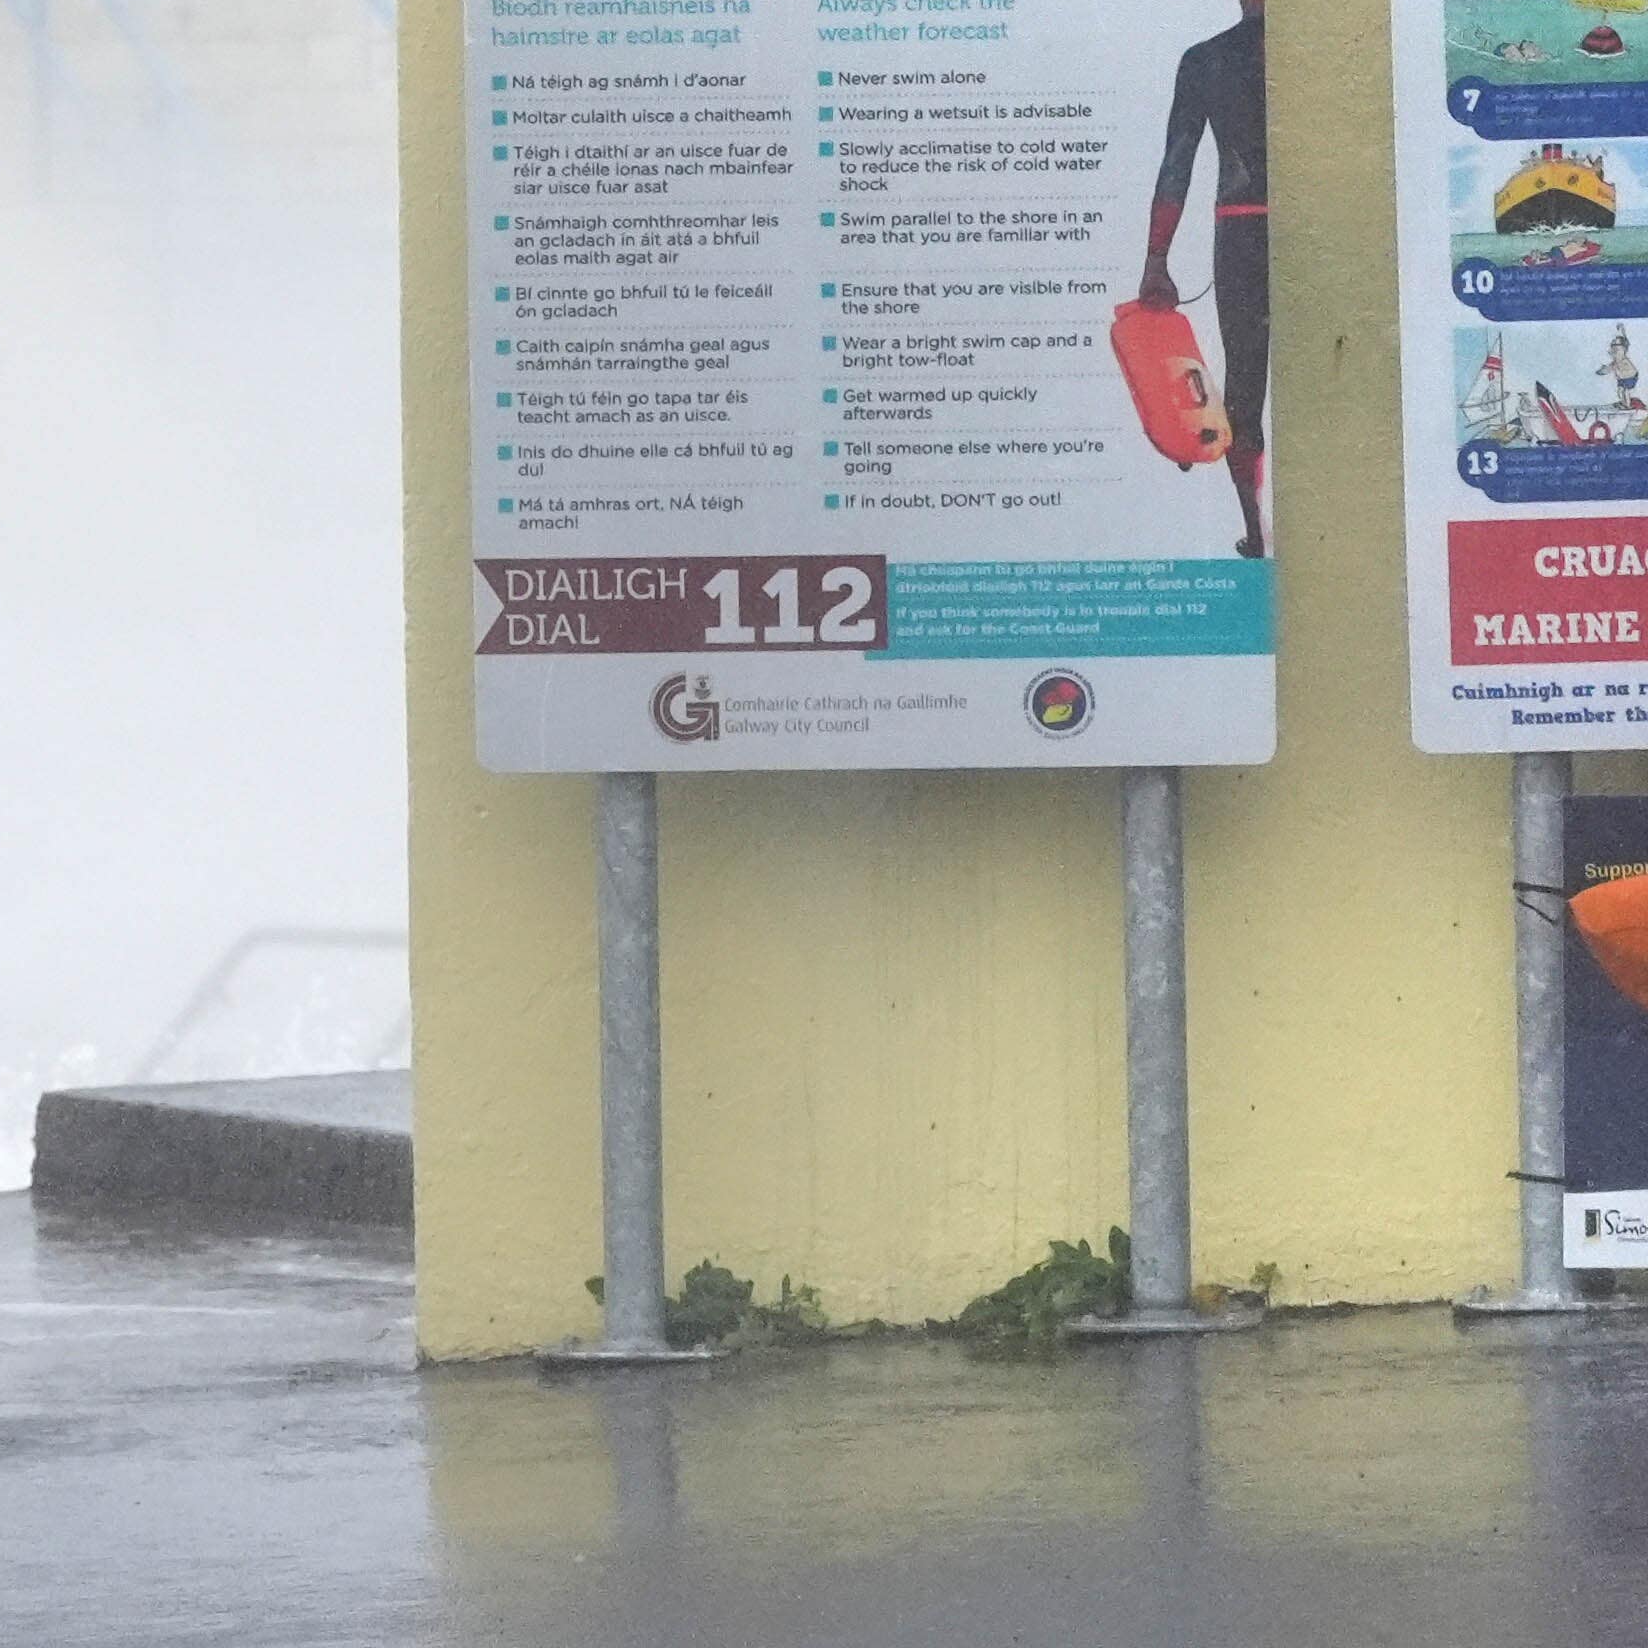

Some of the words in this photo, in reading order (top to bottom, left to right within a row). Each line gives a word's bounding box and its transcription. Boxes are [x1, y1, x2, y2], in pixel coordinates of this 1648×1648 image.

[818, 23, 909, 41] weather
[918, 23, 1007, 40] forecast
[838, 72, 887, 85] Never
[893, 73, 935, 85] swim
[941, 71, 986, 84] alone
[1463, 89, 1480, 111] 7
[838, 108, 908, 122] Wearing
[914, 109, 923, 120] a
[928, 106, 989, 119] wetsuit
[996, 105, 1007, 119] is
[1013, 104, 1092, 118] advisable
[1462, 270, 1493, 293] 10
[842, 301, 869, 314] the
[874, 301, 920, 314] shore
[843, 389, 872, 404] Get
[878, 388, 946, 402] warmed
[952, 391, 973, 403] up
[978, 387, 1037, 403] quickly
[843, 406, 932, 420] afterwards
[1468, 452, 1498, 474] 13
[506, 568, 686, 602] DIAILIGH
[703, 568, 875, 643] 112
[506, 614, 600, 645] DIAL
[1474, 612, 1639, 644] MARINE
[1452, 682, 1563, 702] Cuimhnigh
[1572, 685, 1595, 697] ar
[1605, 685, 1629, 696] na
[724, 697, 799, 712] Comhairle
[804, 696, 868, 710] Cathrach
[874, 699, 891, 710] na
[897, 694, 967, 709] Gaillimhe
[1512, 708, 1615, 724] Remember
[724, 719, 779, 734] Galway
[784, 719, 811, 734] City
[817, 718, 869, 732] Council
